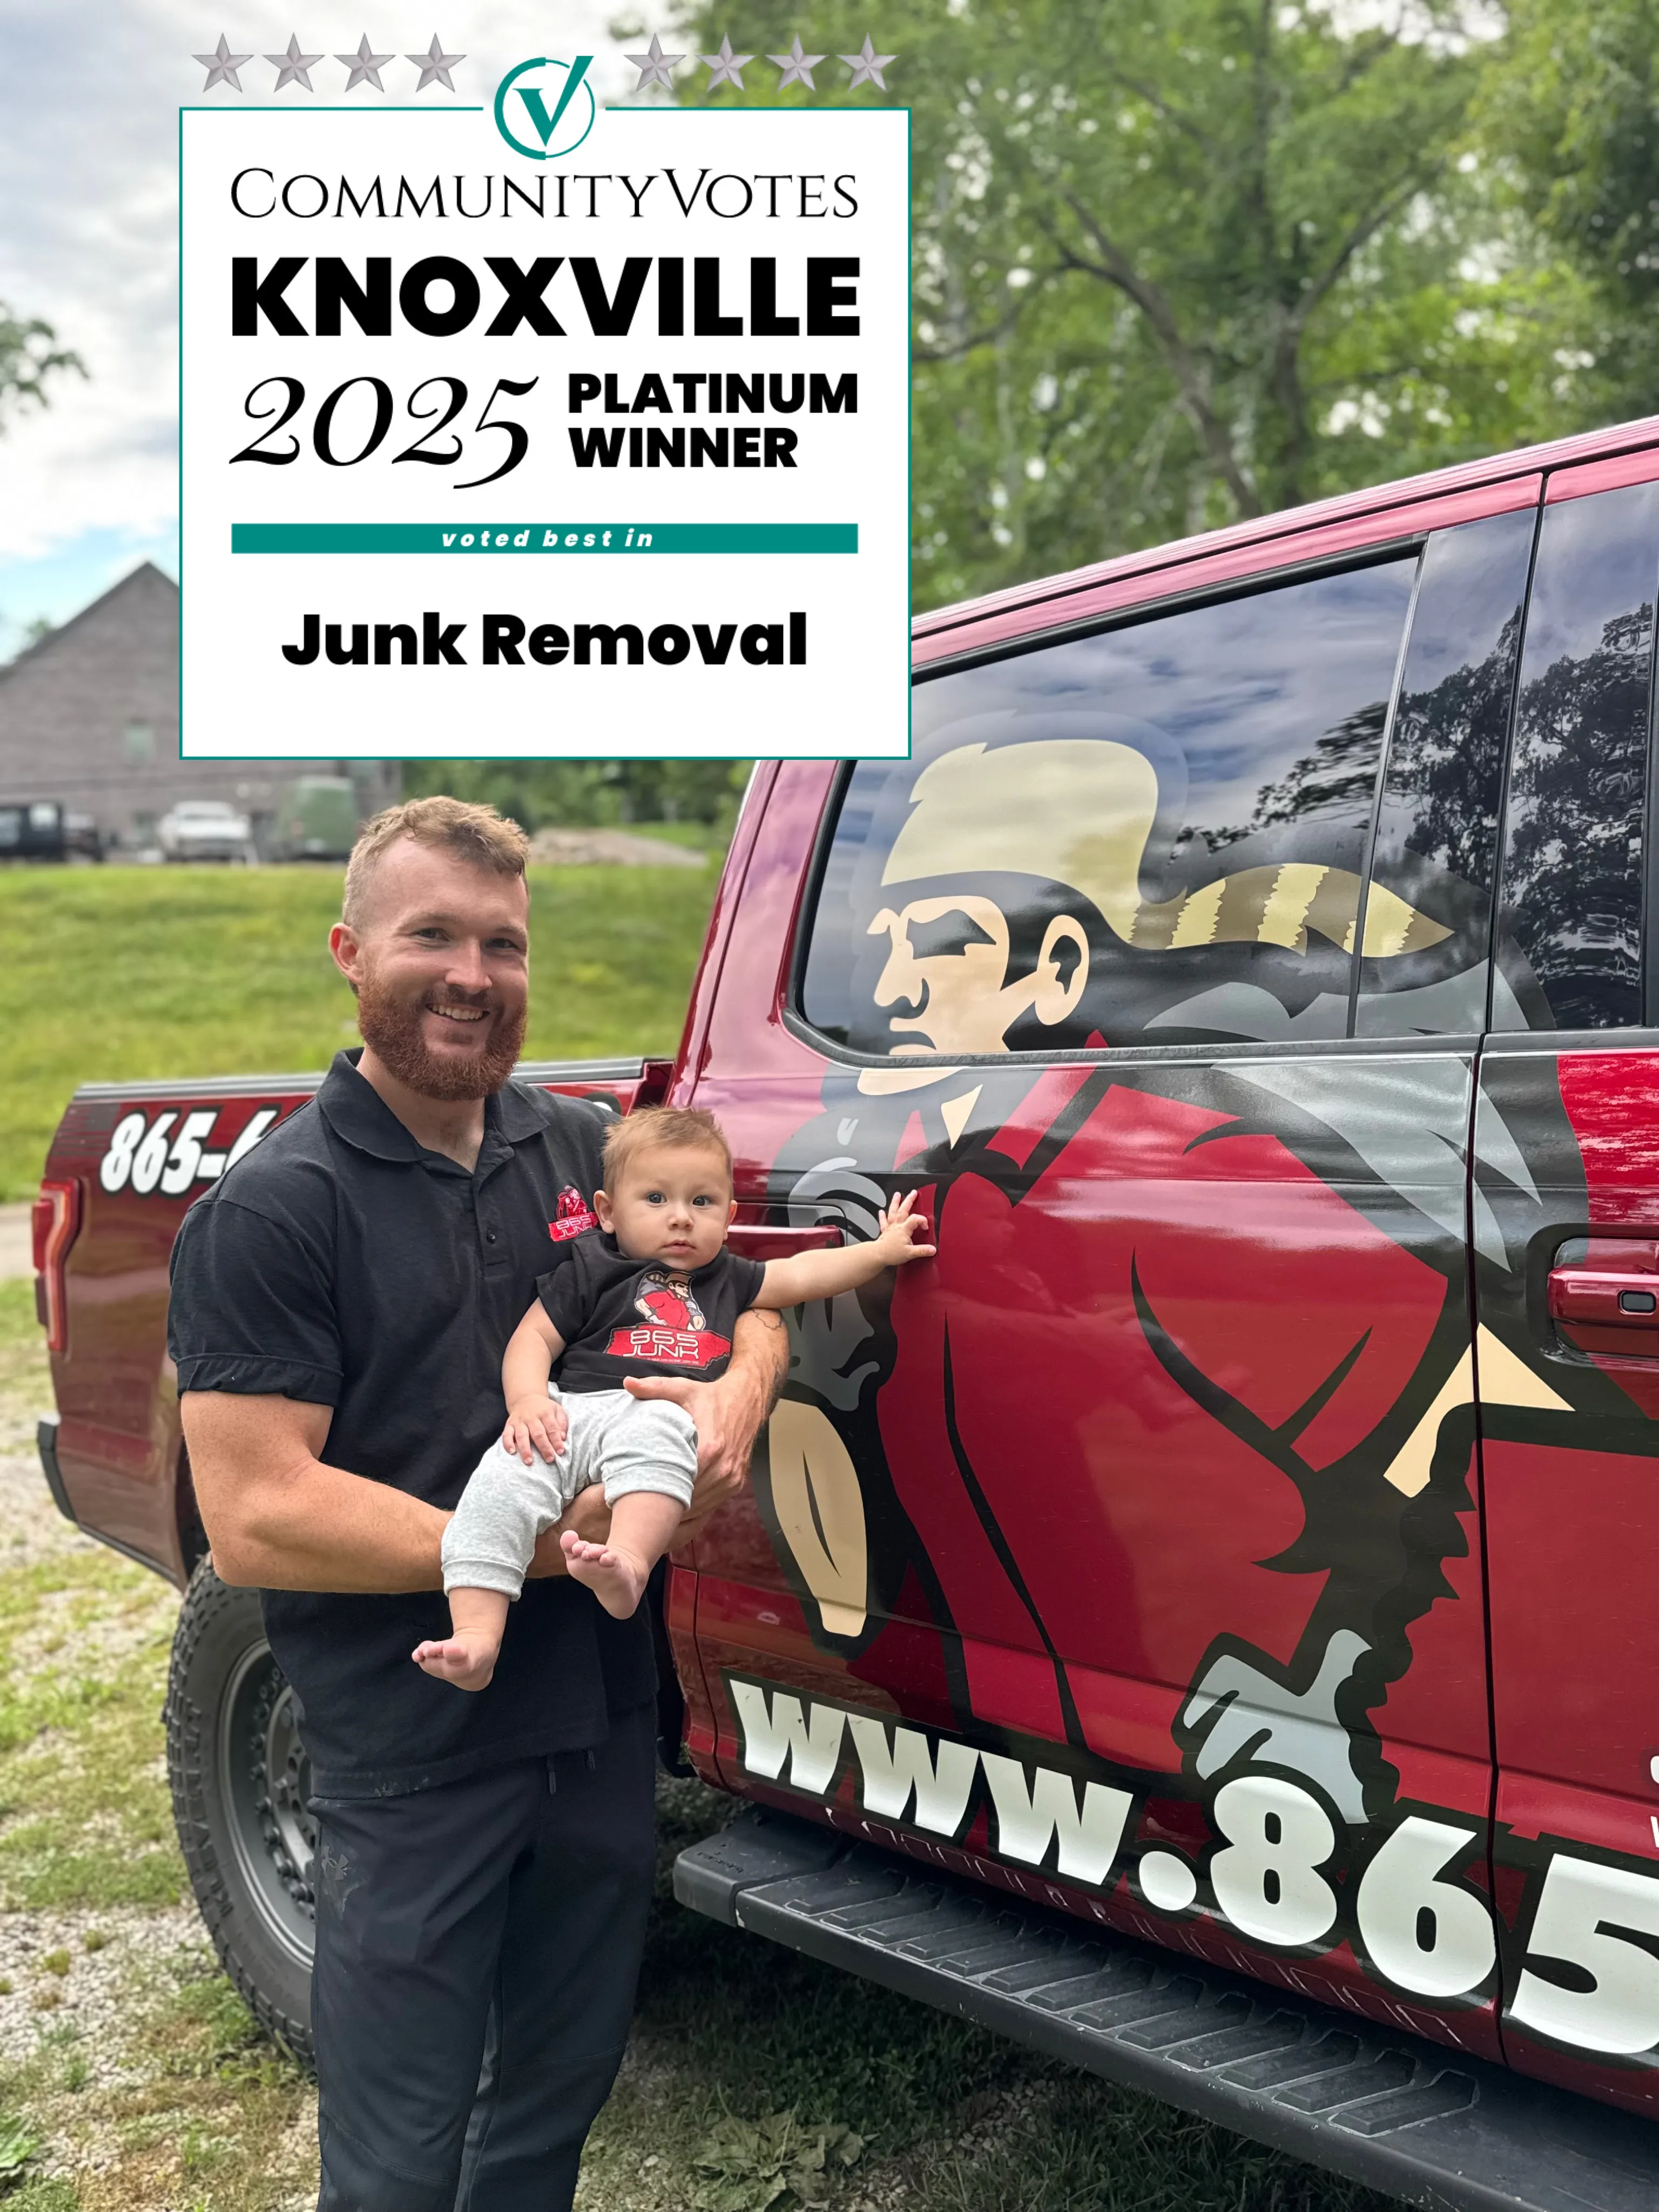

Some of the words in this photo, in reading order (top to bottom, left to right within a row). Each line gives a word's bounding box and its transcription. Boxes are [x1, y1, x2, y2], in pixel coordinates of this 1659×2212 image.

[556, 1214, 592, 1230] 865
[630, 1330, 699, 1347] 865
[622, 1344, 699, 1360] JUNK
